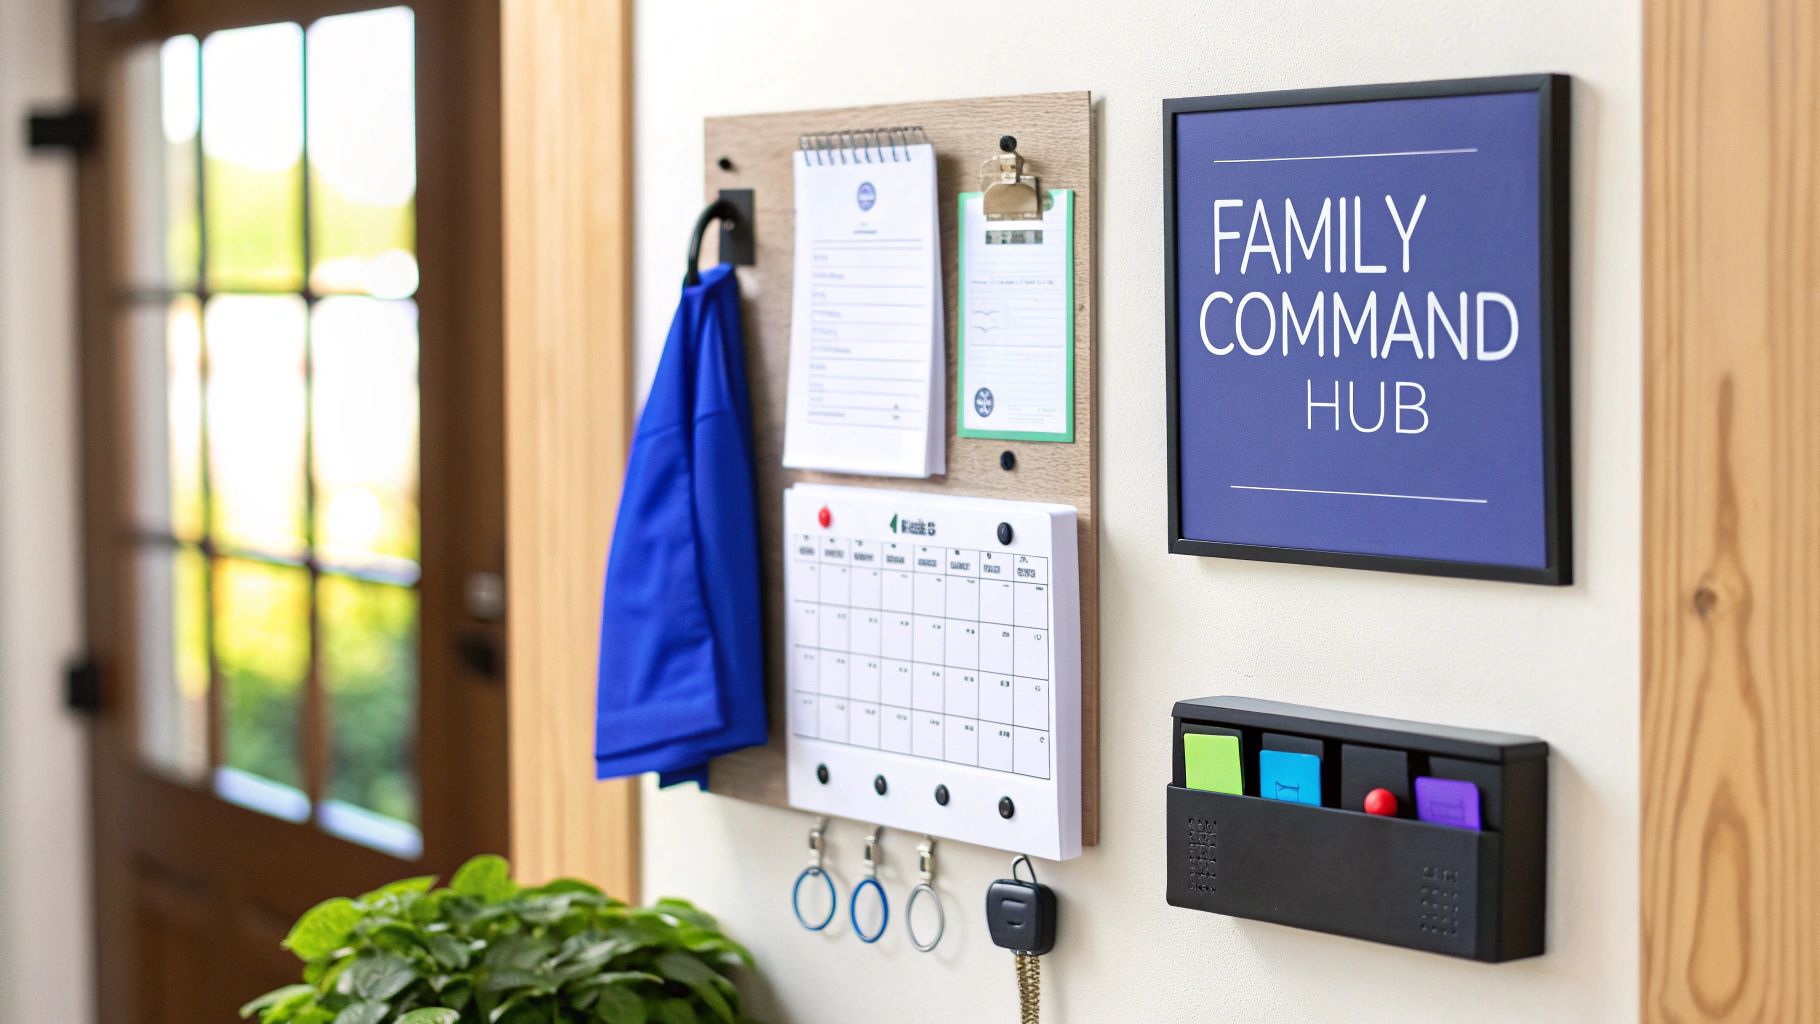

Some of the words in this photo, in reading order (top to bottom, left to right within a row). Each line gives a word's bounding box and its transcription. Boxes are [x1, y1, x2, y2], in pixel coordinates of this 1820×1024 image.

[1213, 194, 1427, 275] FAMILY
[1200, 290, 1519, 361] COMMAND
[1307, 379, 1429, 434] HUB
